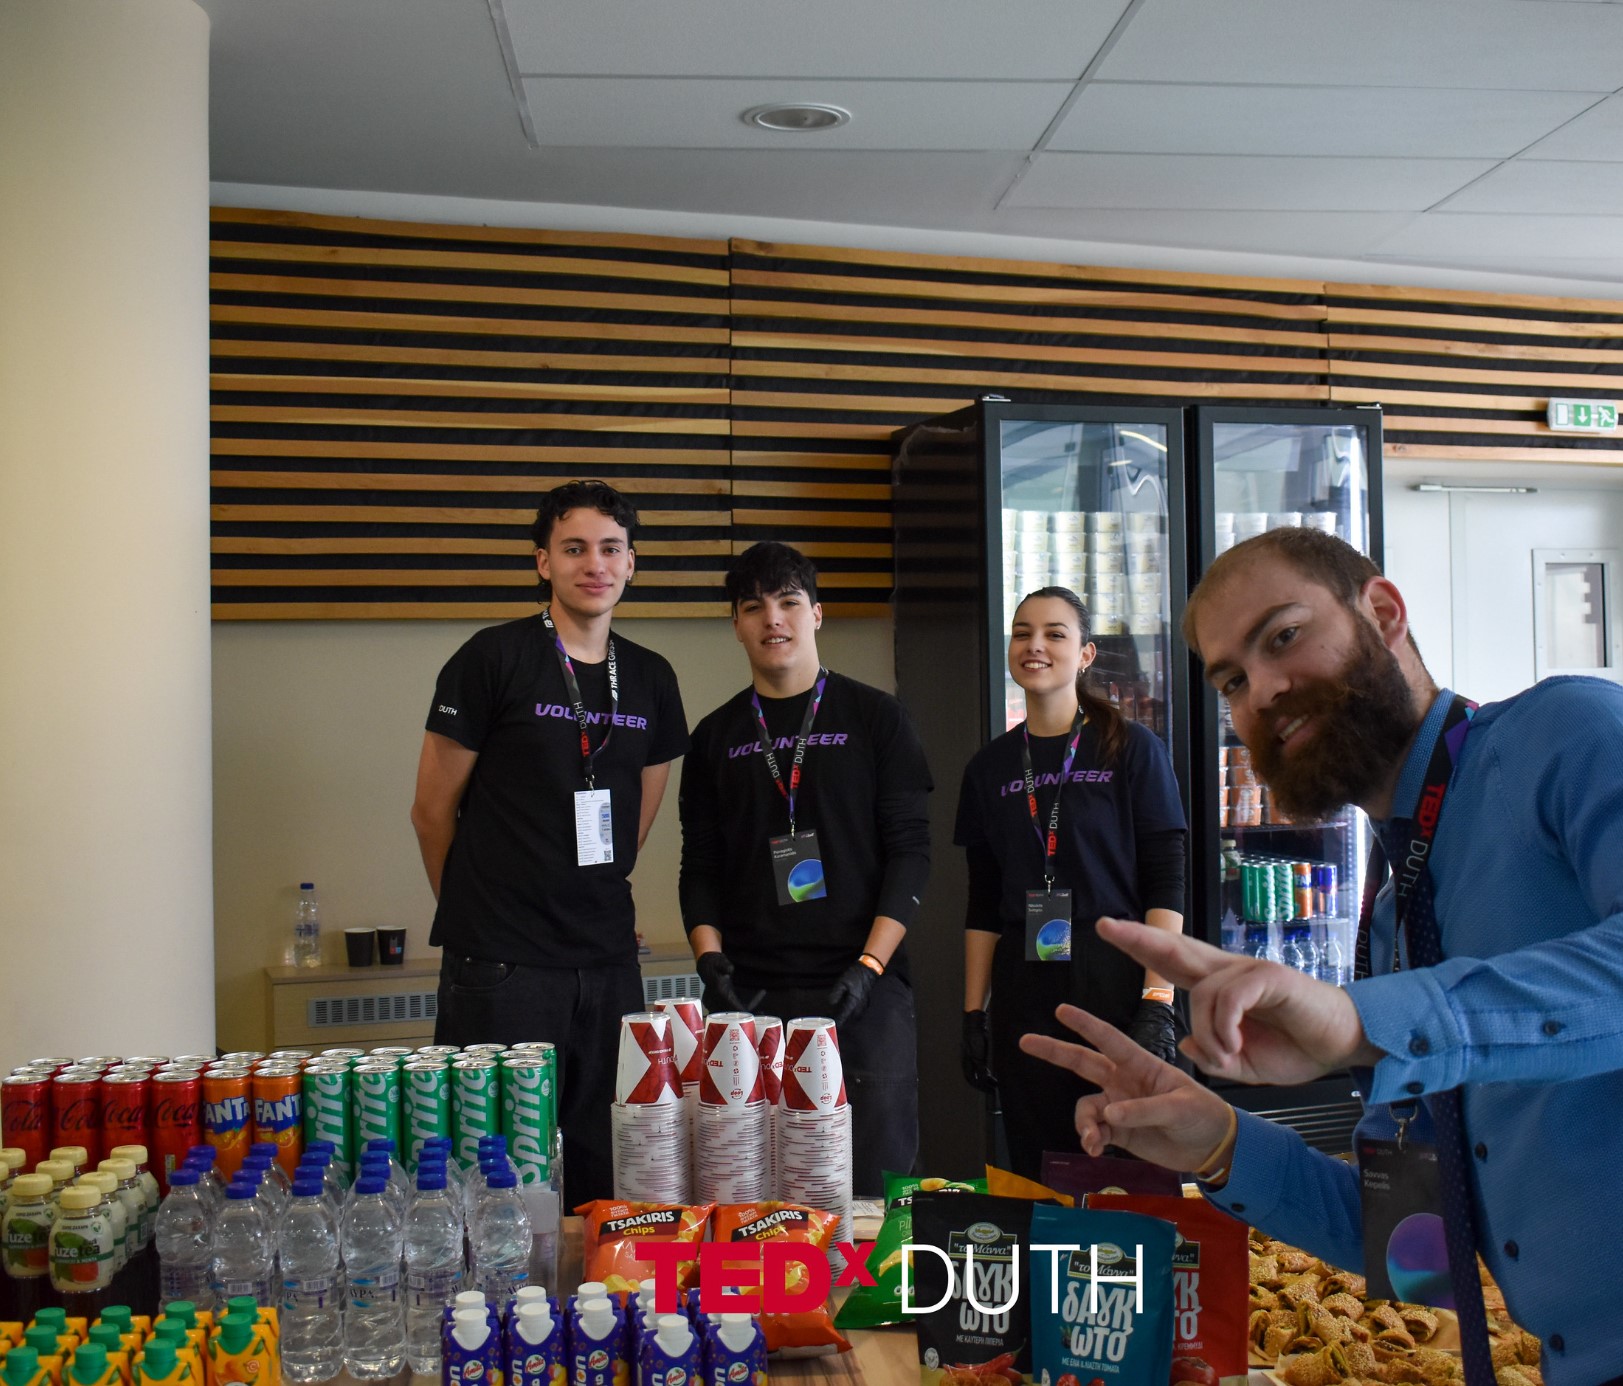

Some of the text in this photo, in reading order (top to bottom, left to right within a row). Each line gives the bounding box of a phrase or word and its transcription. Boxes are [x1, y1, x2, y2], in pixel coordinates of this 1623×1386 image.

[608, 661, 618, 689] THRACE
[438, 704, 458, 716] DUTH
[535, 703, 647, 730] VOLNTEER
[255, 1094, 301, 1123] FANT
[454, 1069, 487, 1170] prite
[607, 1211, 674, 1231] TSAKIRIS
[623, 1226, 655, 1236] Chips
[738, 1210, 803, 1237] TSAKIRIS
[9, 1232, 33, 1244] uze
[55, 1246, 79, 1258] uze
